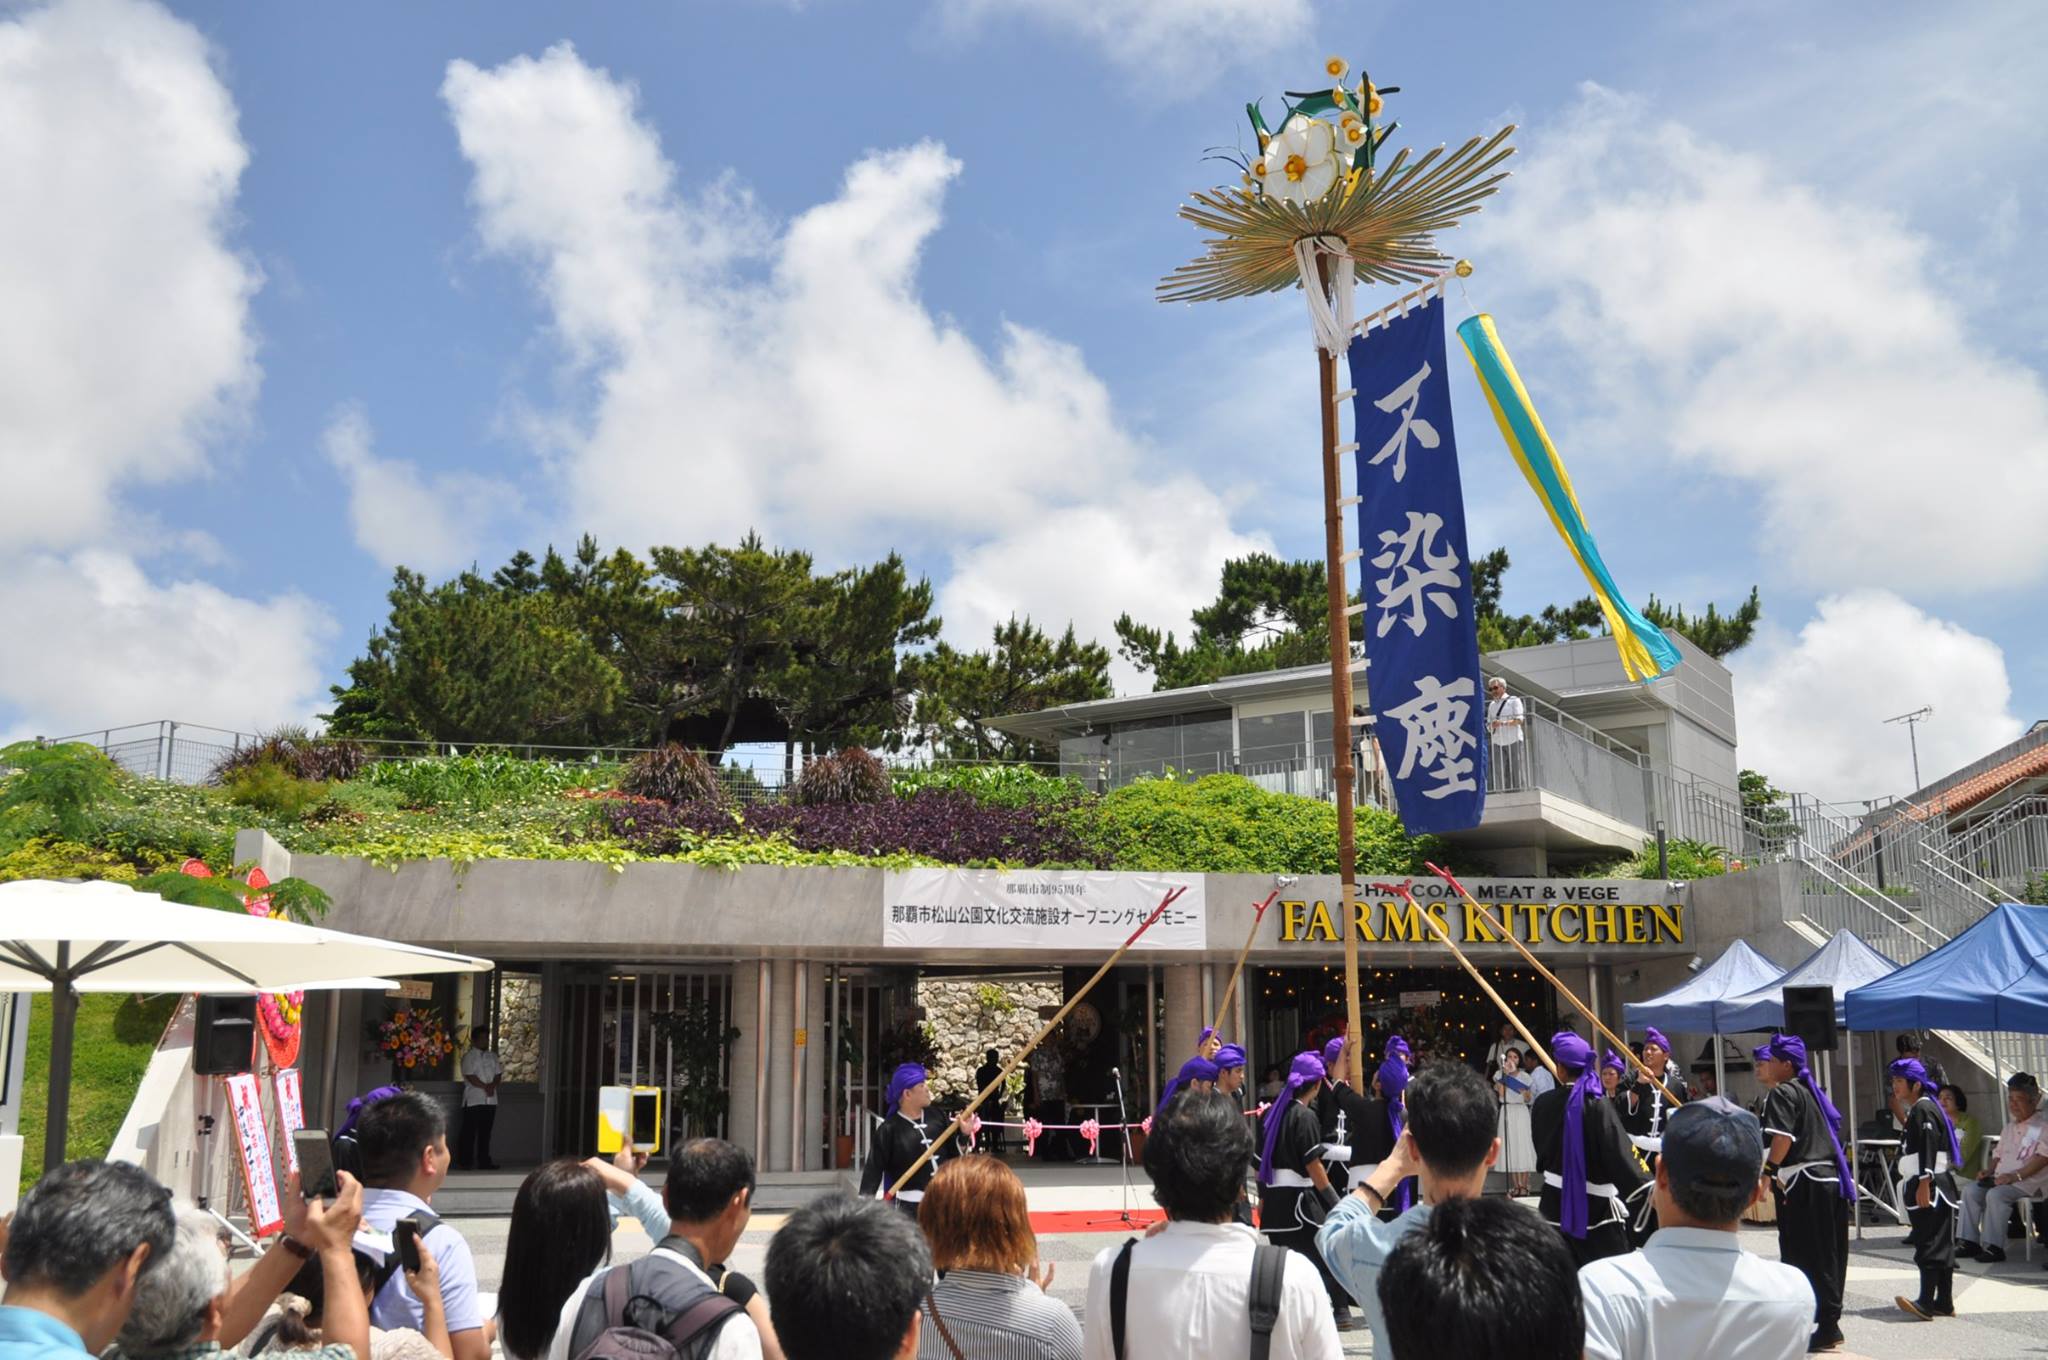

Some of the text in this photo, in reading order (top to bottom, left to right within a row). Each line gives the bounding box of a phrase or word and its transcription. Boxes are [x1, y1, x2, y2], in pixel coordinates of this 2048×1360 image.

[1368, 360, 1478, 800] 不染塵
[1006, 883, 1087, 896] 那覇市制95周年
[1478, 885, 1535, 899] MEAT
[1543, 886, 1556, 899] &
[1563, 886, 1619, 900] VEGE
[1278, 900, 1684, 944] FARMS KITCHEN
